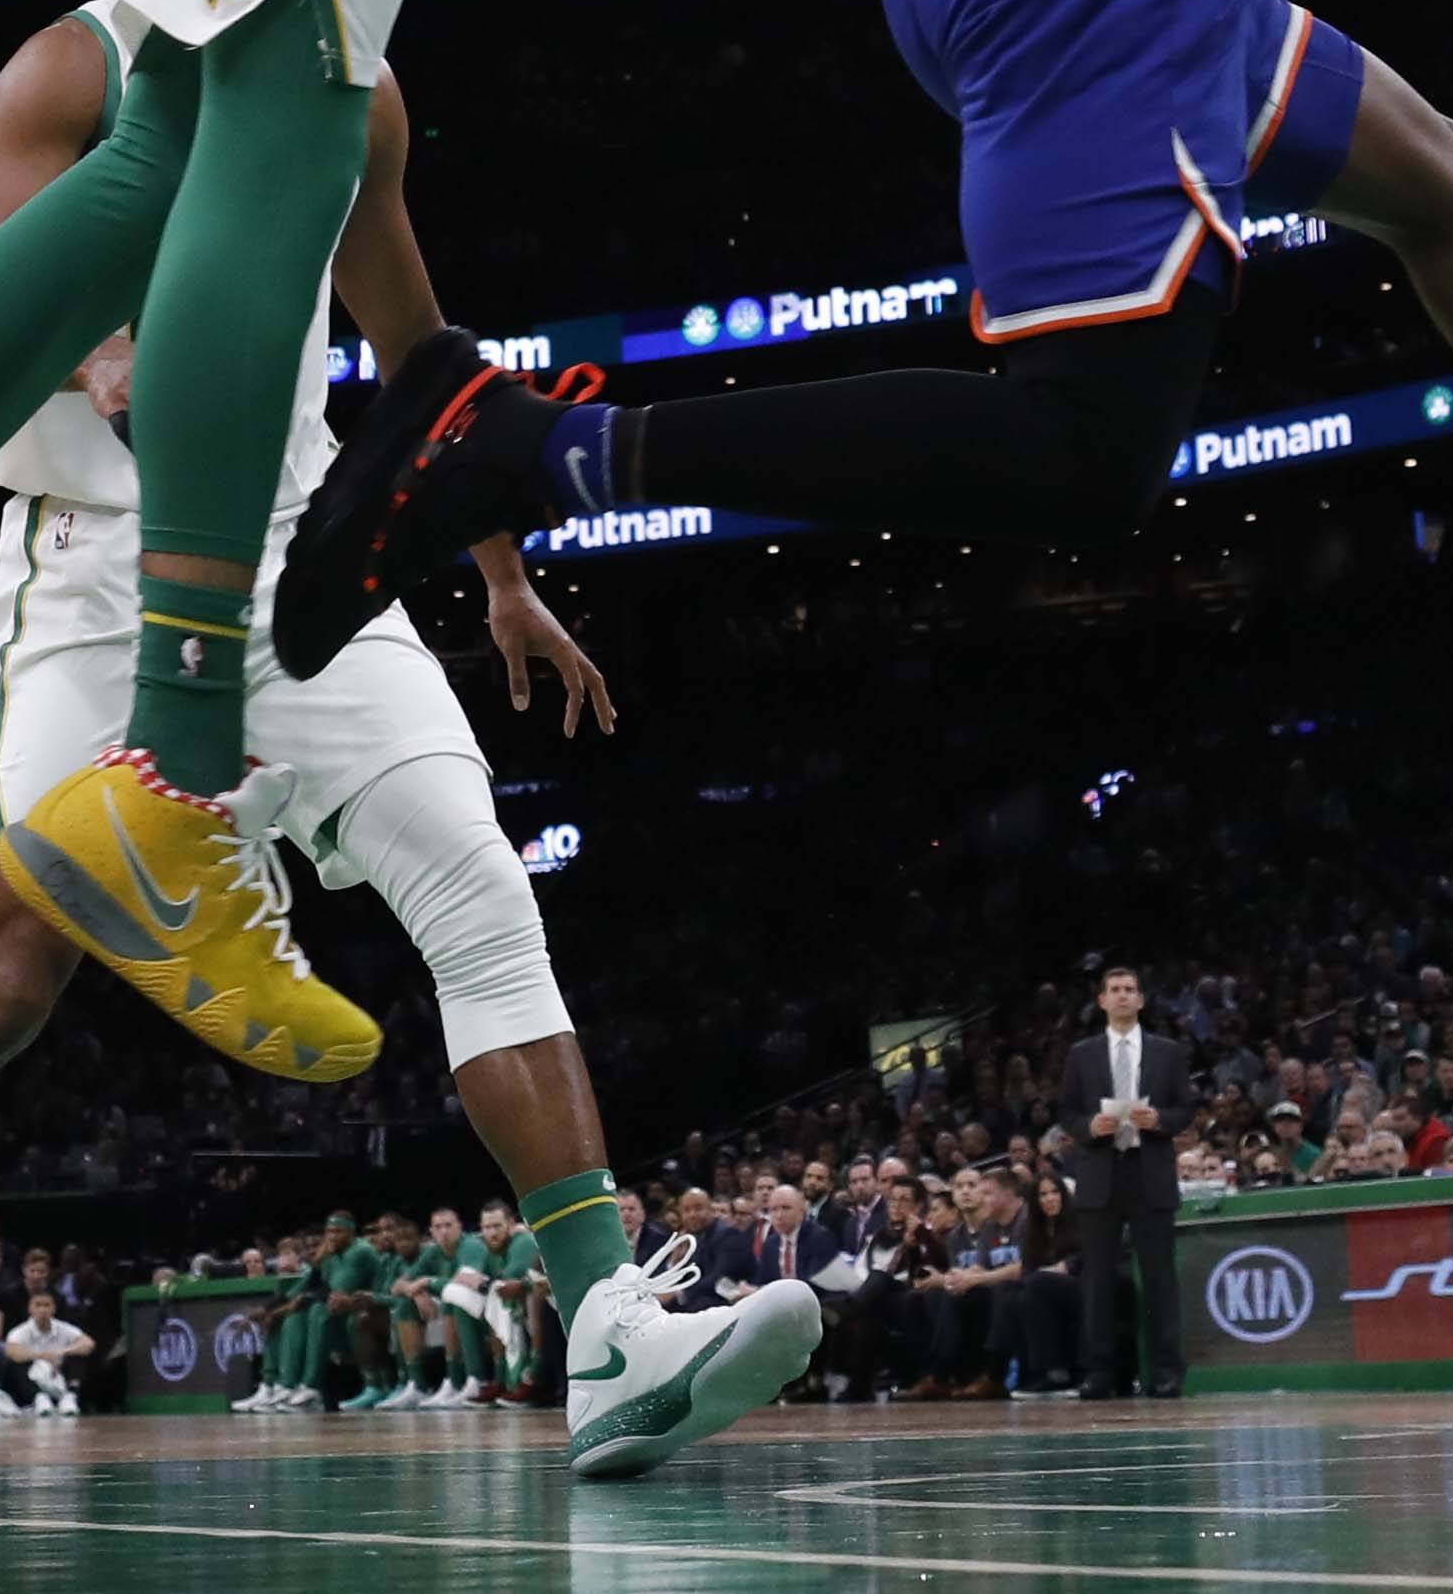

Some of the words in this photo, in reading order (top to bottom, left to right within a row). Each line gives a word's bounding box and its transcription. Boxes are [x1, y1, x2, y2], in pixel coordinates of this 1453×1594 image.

[1196, 412, 1352, 475] Putnam
[549, 506, 712, 551] Putnam
[540, 824, 582, 860] 10
[1225, 1268, 1292, 1322] KIA
